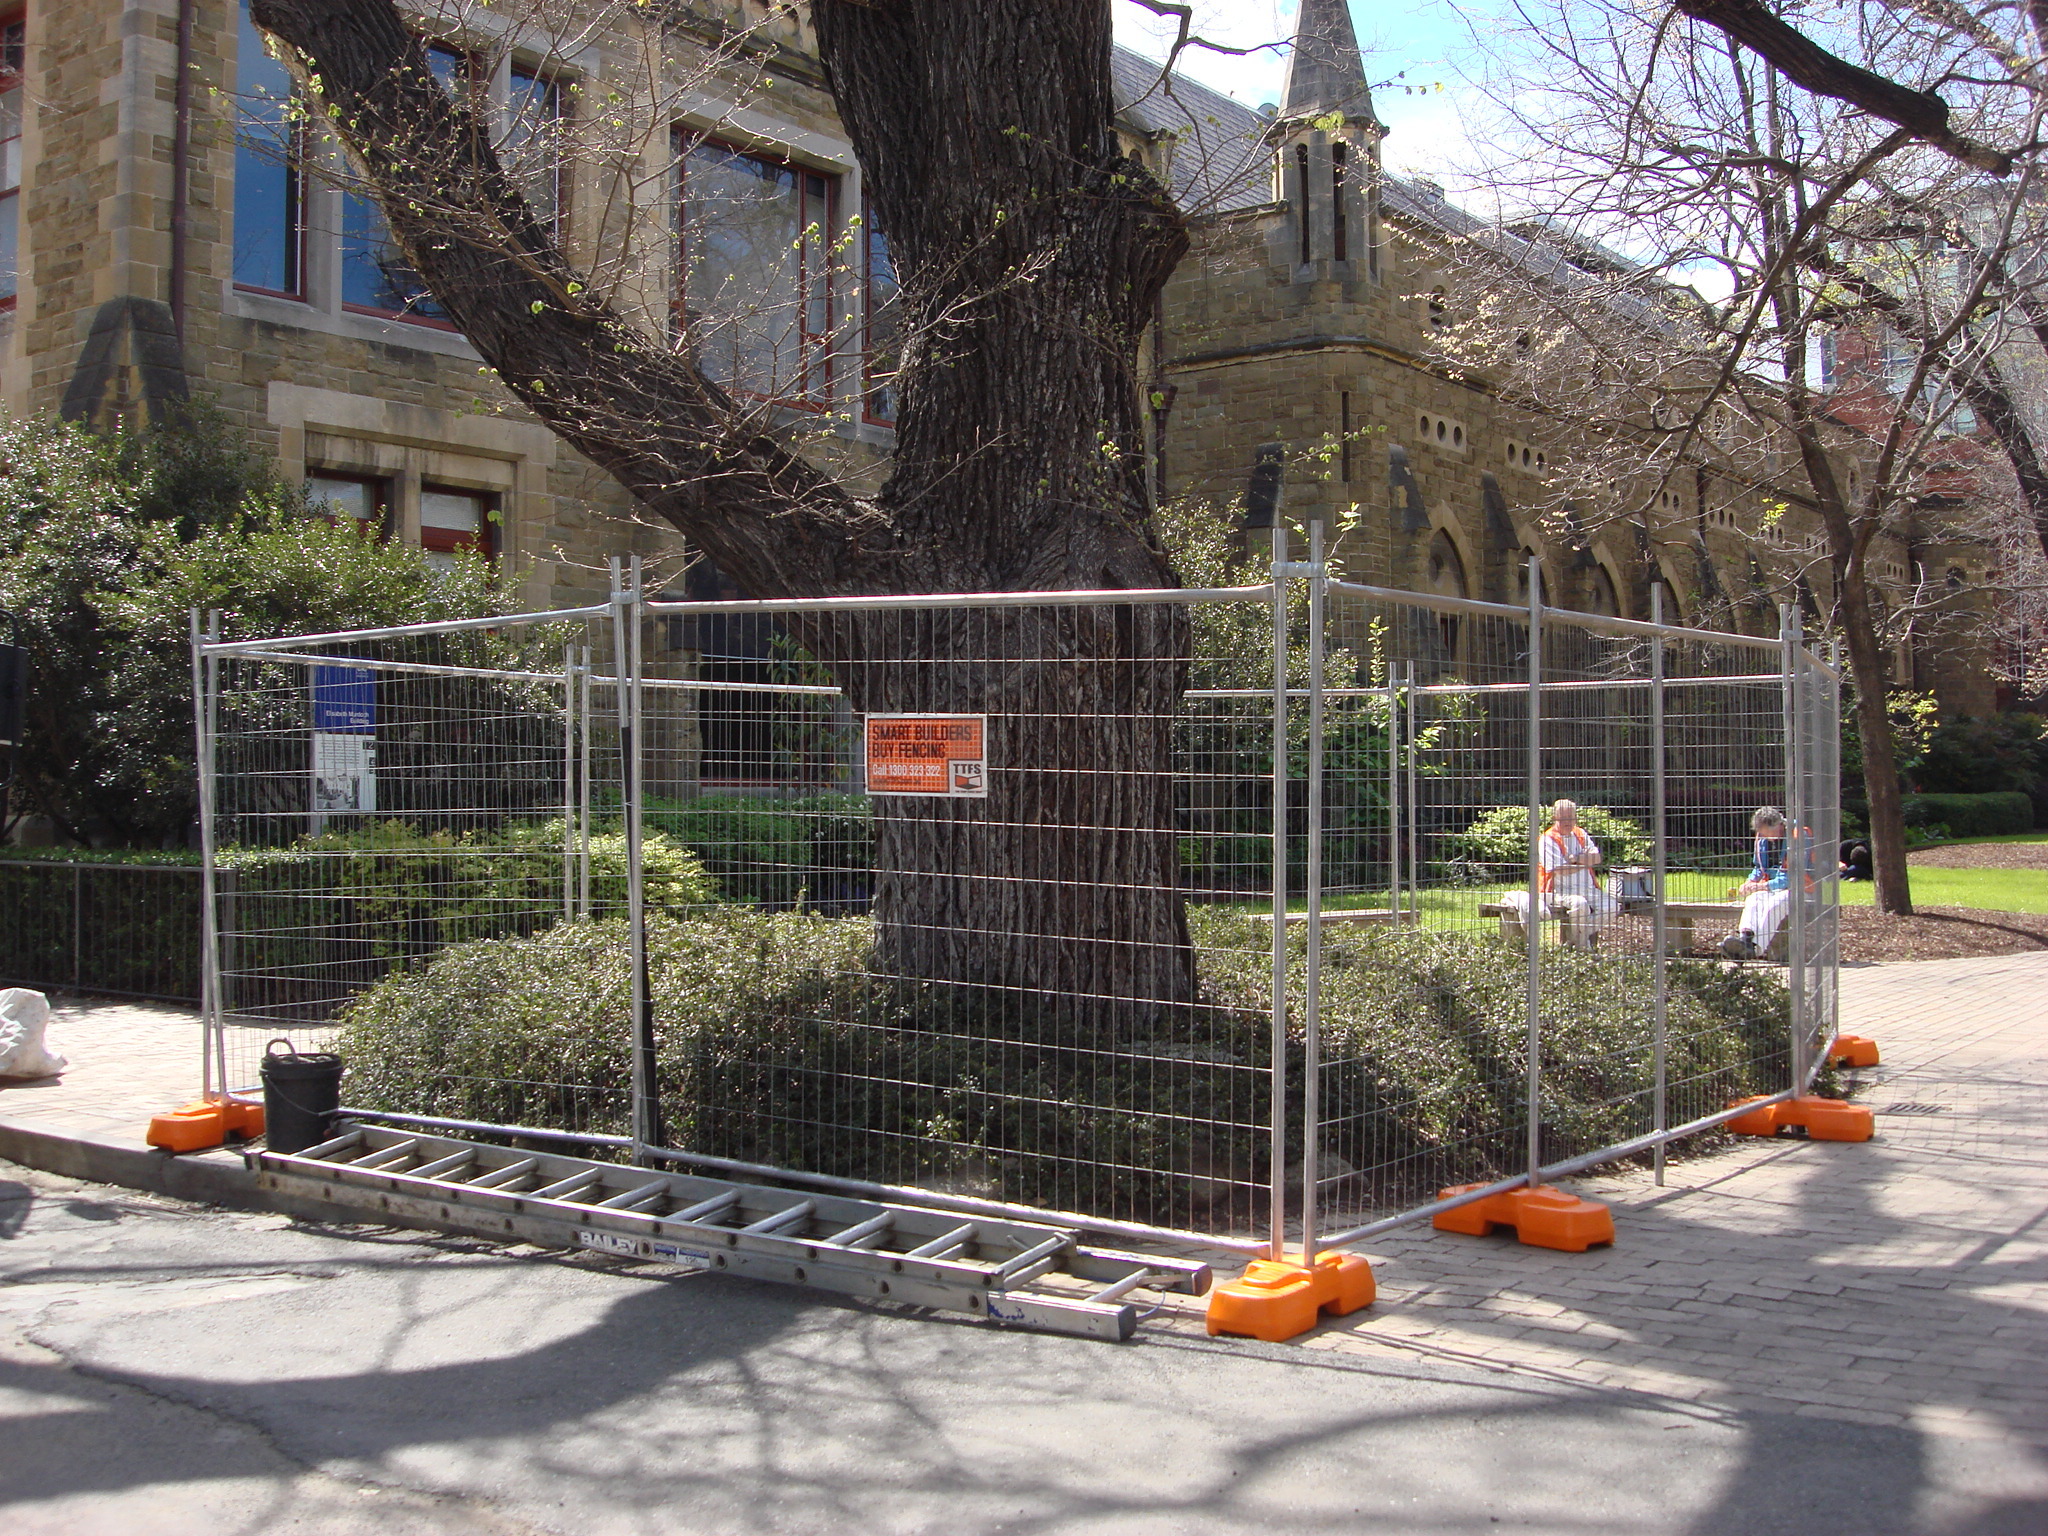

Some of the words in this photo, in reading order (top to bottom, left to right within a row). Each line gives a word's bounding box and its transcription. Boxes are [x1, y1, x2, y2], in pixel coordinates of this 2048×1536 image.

[873, 725, 910, 741] SMART
[915, 725, 973, 741] BUILDERS
[873, 742, 895, 758] BUY
[898, 742, 946, 758] FENCING
[873, 764, 887, 776] Call
[890, 764, 907, 777] 1300
[910, 765, 924, 777] 323
[926, 765, 941, 777] 322
[953, 763, 982, 775] TTFS
[580, 1231, 638, 1254] BAILEY
